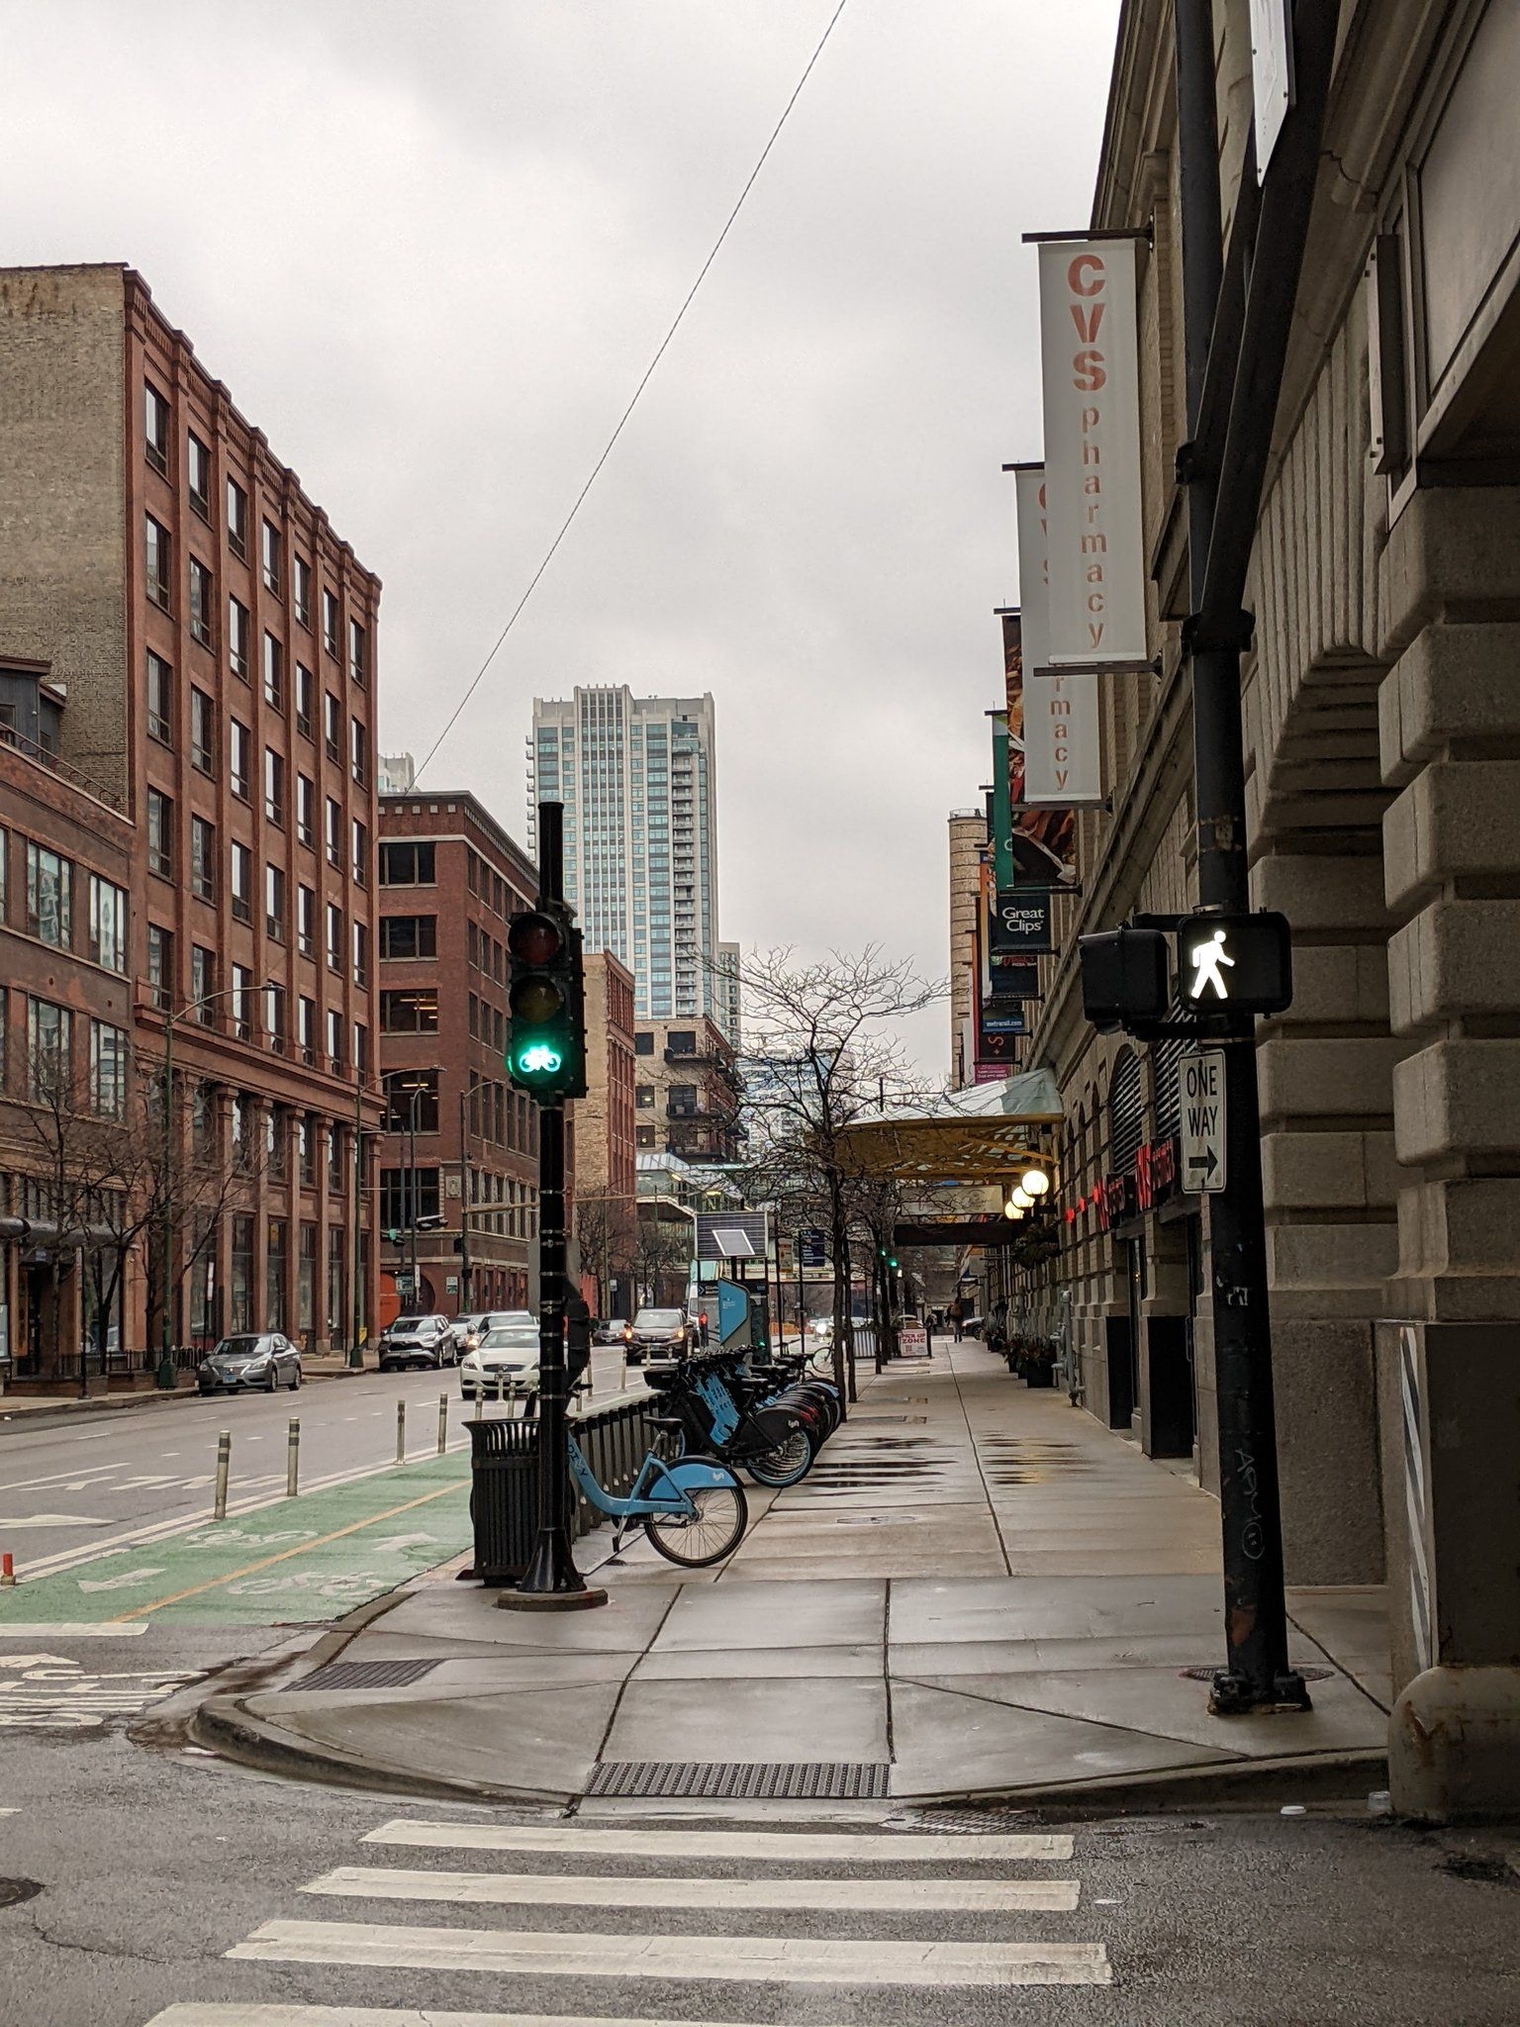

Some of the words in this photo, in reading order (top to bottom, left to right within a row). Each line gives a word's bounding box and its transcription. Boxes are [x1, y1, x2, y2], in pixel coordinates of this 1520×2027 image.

[1067, 253, 1107, 392] CVS
[1080, 406, 1109, 649] pharmacy
[1050, 677, 1071, 791] rmacy
[1002, 906, 1044, 919] Great
[1006, 919, 1041, 934] Clips
[1186, 1066, 1217, 1098] ONE
[1188, 1105, 1218, 1137] WAY
